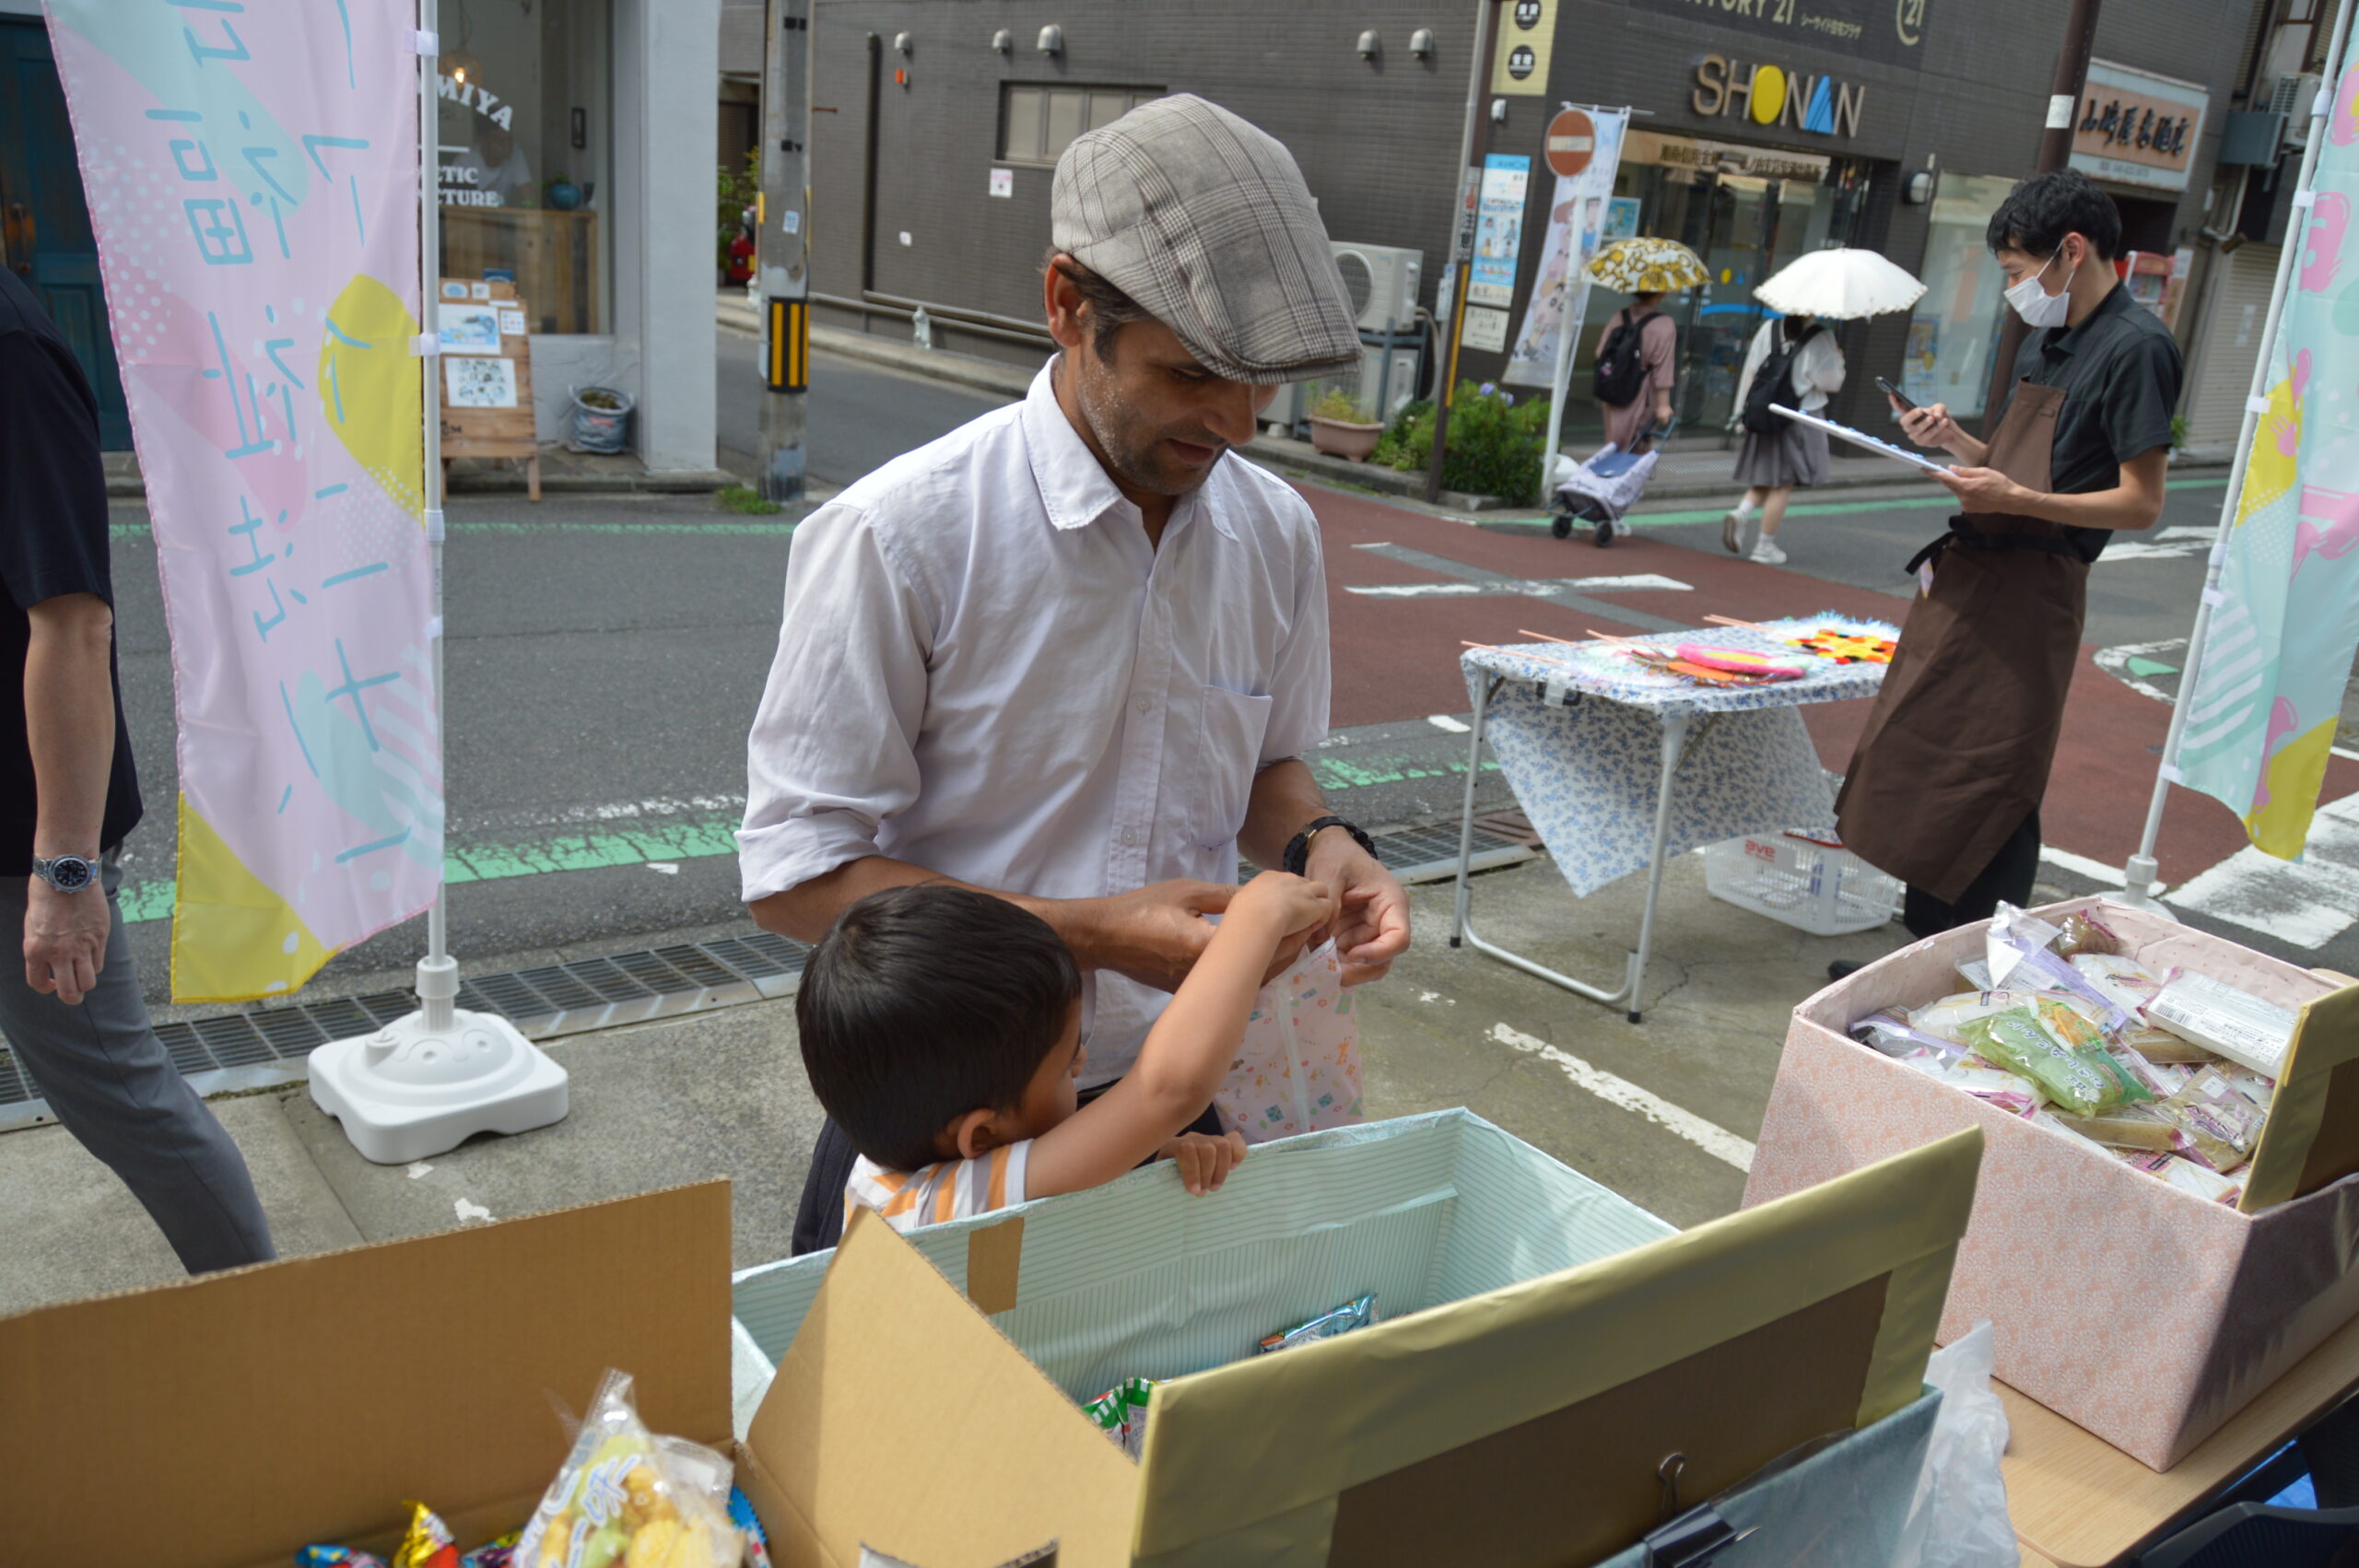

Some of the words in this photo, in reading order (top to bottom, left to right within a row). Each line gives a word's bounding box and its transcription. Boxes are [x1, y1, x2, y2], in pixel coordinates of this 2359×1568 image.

[437, 73, 514, 132] MIYA
[1692, 53, 1866, 139] SHONAN
[437, 165, 478, 183] TIC
[437, 189, 499, 207] TURE
